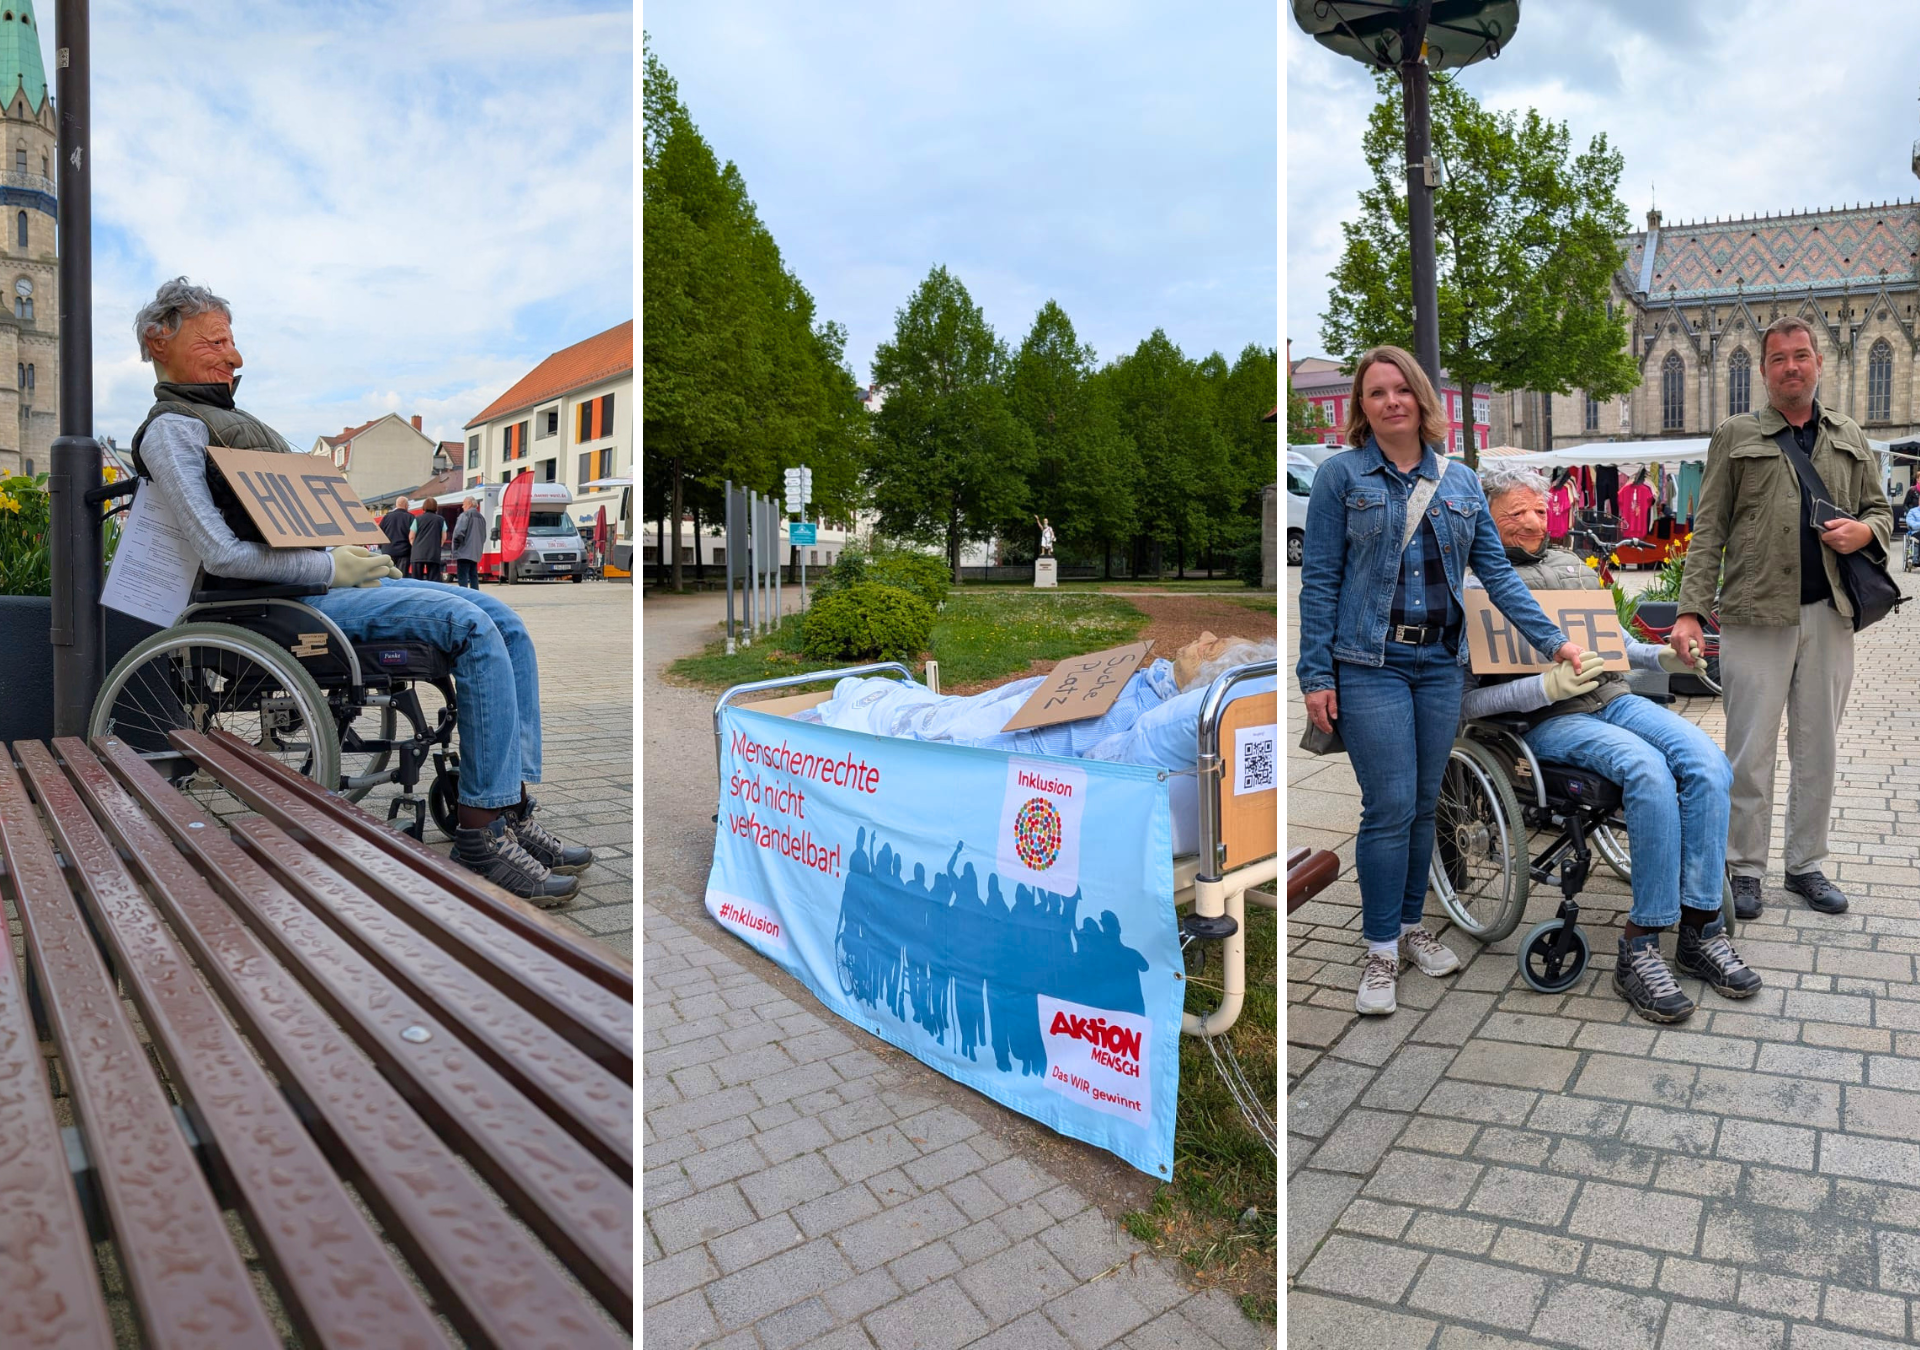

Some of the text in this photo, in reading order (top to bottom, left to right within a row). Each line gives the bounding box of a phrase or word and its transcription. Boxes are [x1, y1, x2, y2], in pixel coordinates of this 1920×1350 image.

[237, 471, 378, 537] HILFE
[1479, 609, 1623, 665] HIFE
[1082, 654, 1136, 701] Suche
[731, 730, 880, 794] Menschenrechte
[1018, 770, 1073, 798] Inklusion
[730, 769, 805, 819] sind nicht
[729, 812, 840, 878] verhandelbar!
[719, 903, 780, 938] #Inklusion
[1091, 1047, 1140, 1078] MENSCH
[1052, 1065, 1142, 1112] Das WIR gewinnt
